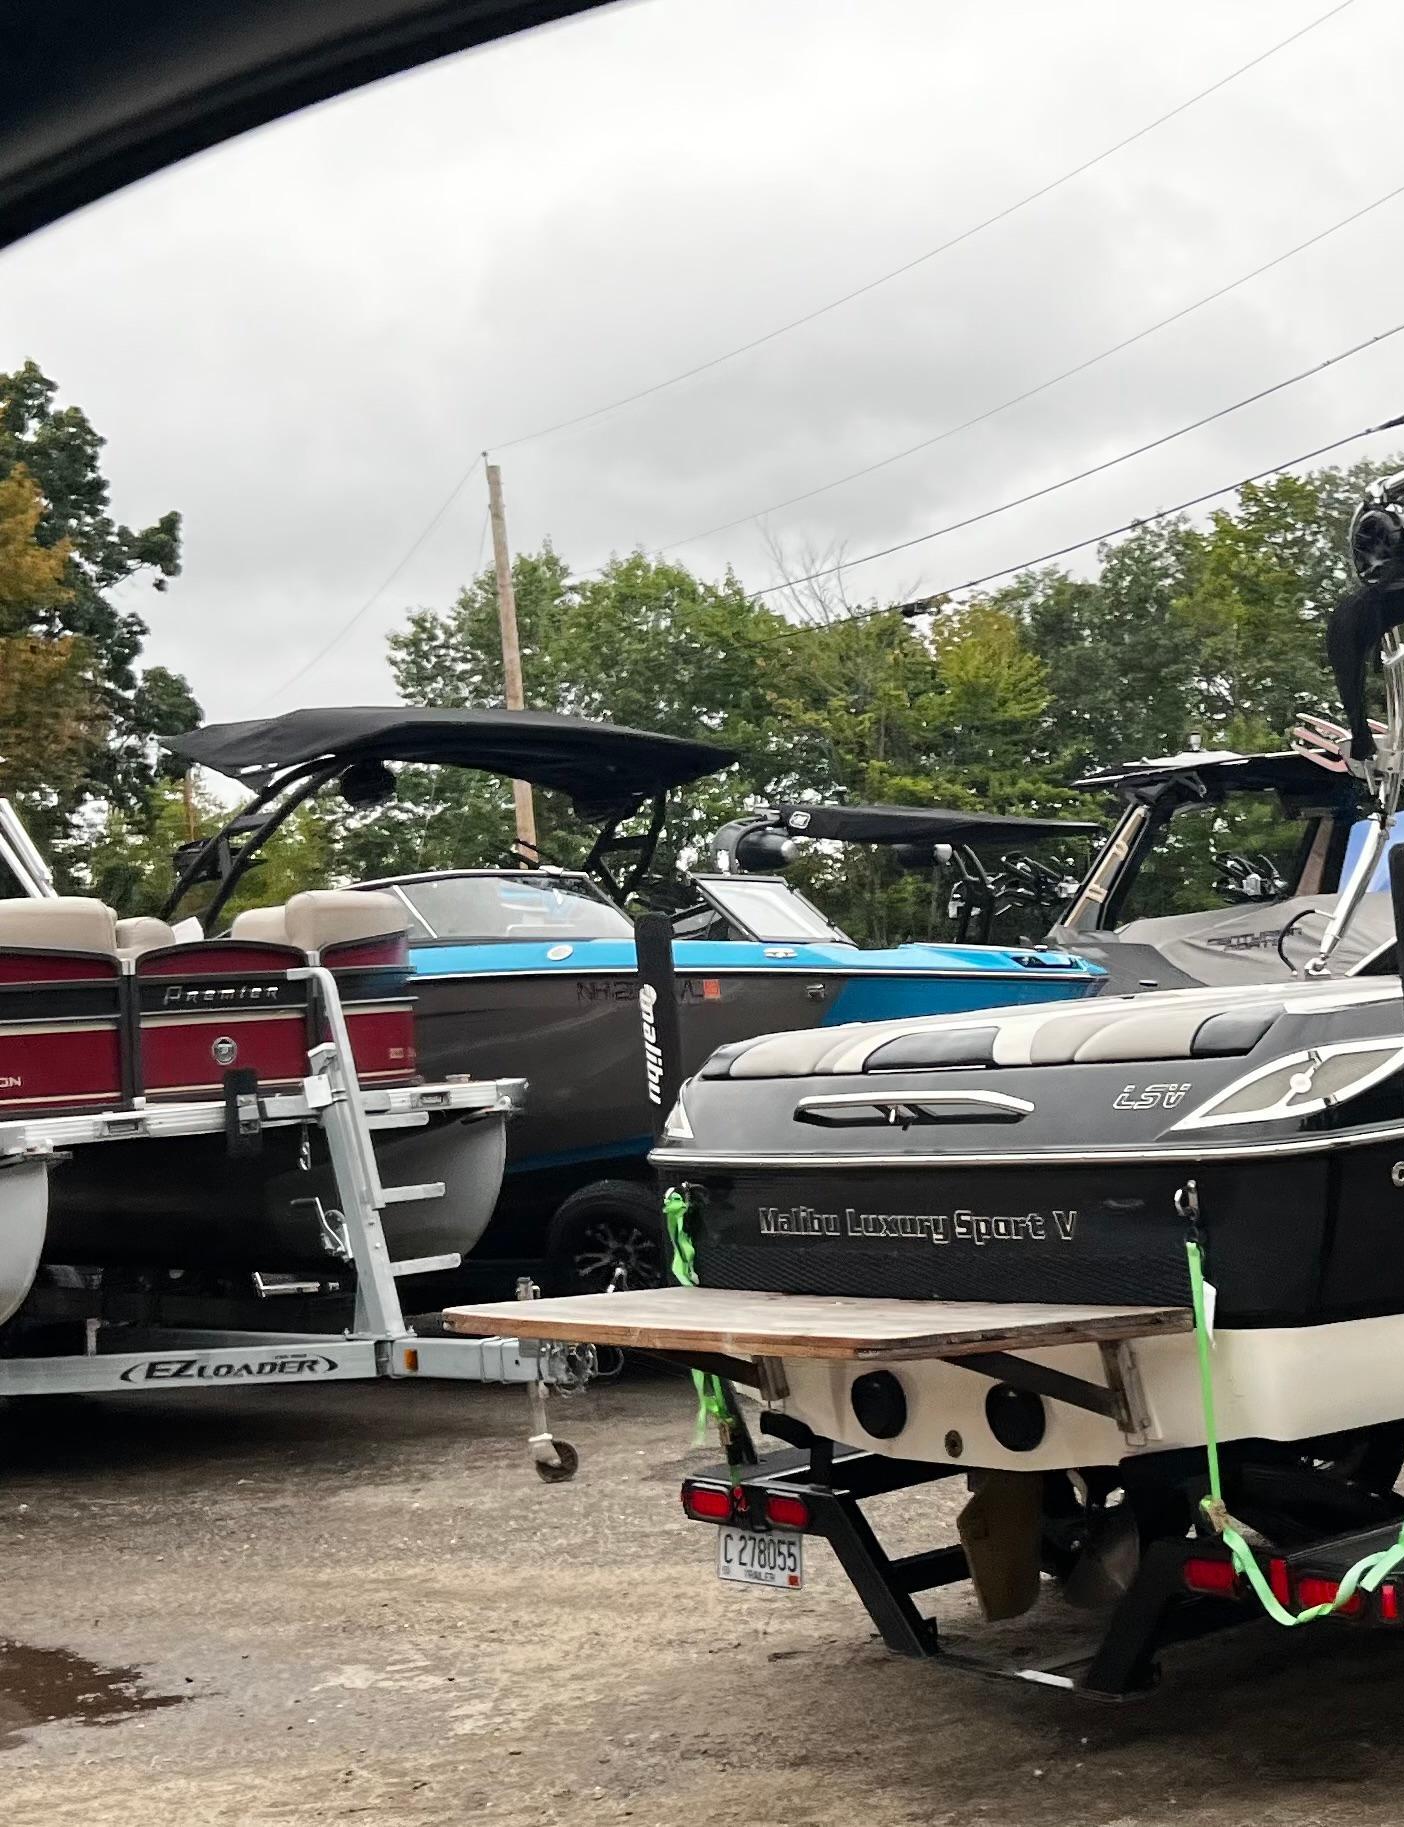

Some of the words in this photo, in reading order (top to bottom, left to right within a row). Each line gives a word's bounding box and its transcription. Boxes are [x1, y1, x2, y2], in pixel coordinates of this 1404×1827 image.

[639, 983, 664, 1105] malibu
[1112, 1082, 1192, 1110] LSV
[758, 1206, 841, 1235] Malibu
[845, 1208, 950, 1244] Luxury
[953, 1209, 1046, 1246] Sport
[1052, 1210, 1077, 1240] V
[724, 1533, 734, 1564] C
[738, 1534, 797, 1573] 278055
